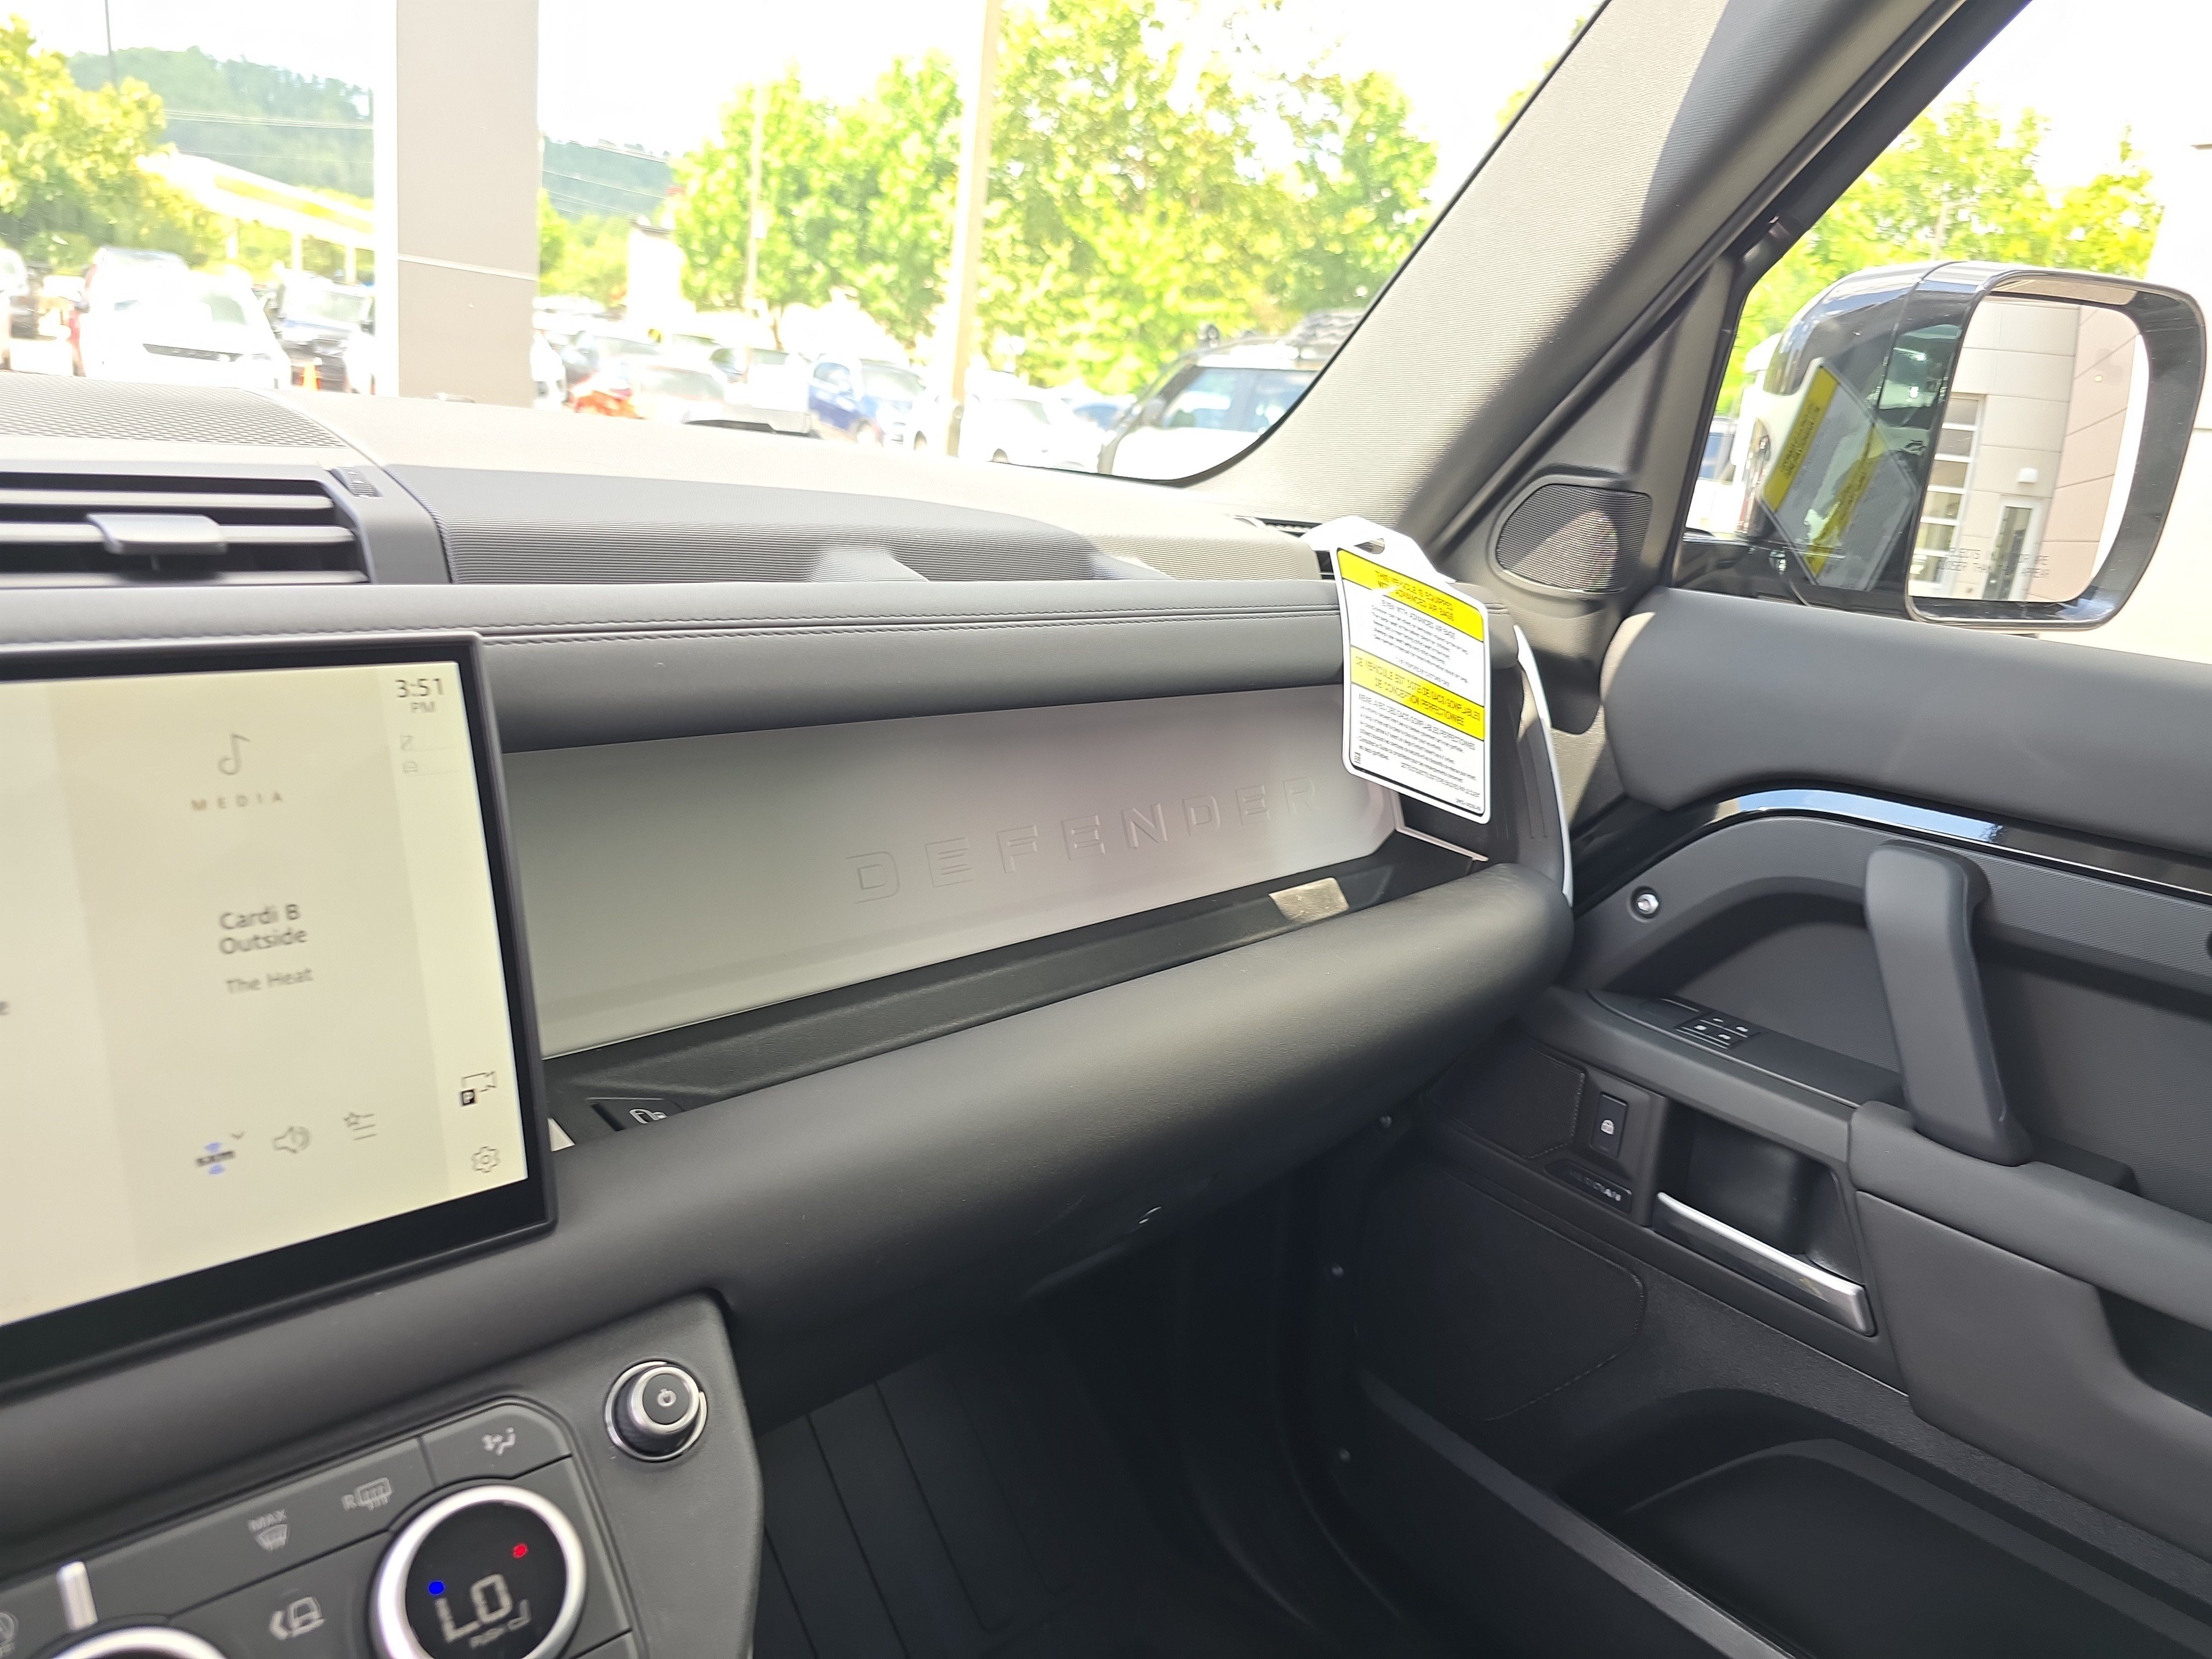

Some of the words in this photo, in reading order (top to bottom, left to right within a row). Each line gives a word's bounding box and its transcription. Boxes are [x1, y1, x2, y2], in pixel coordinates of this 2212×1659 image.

[395, 678, 443, 698] 3:51
[411, 701, 436, 713] PM
[191, 791, 282, 812] MEDIA
[844, 776, 1317, 904] DEFENDER
[219, 905, 279, 929] Cardi
[285, 903, 301, 921] B
[219, 927, 307, 955] Outside
